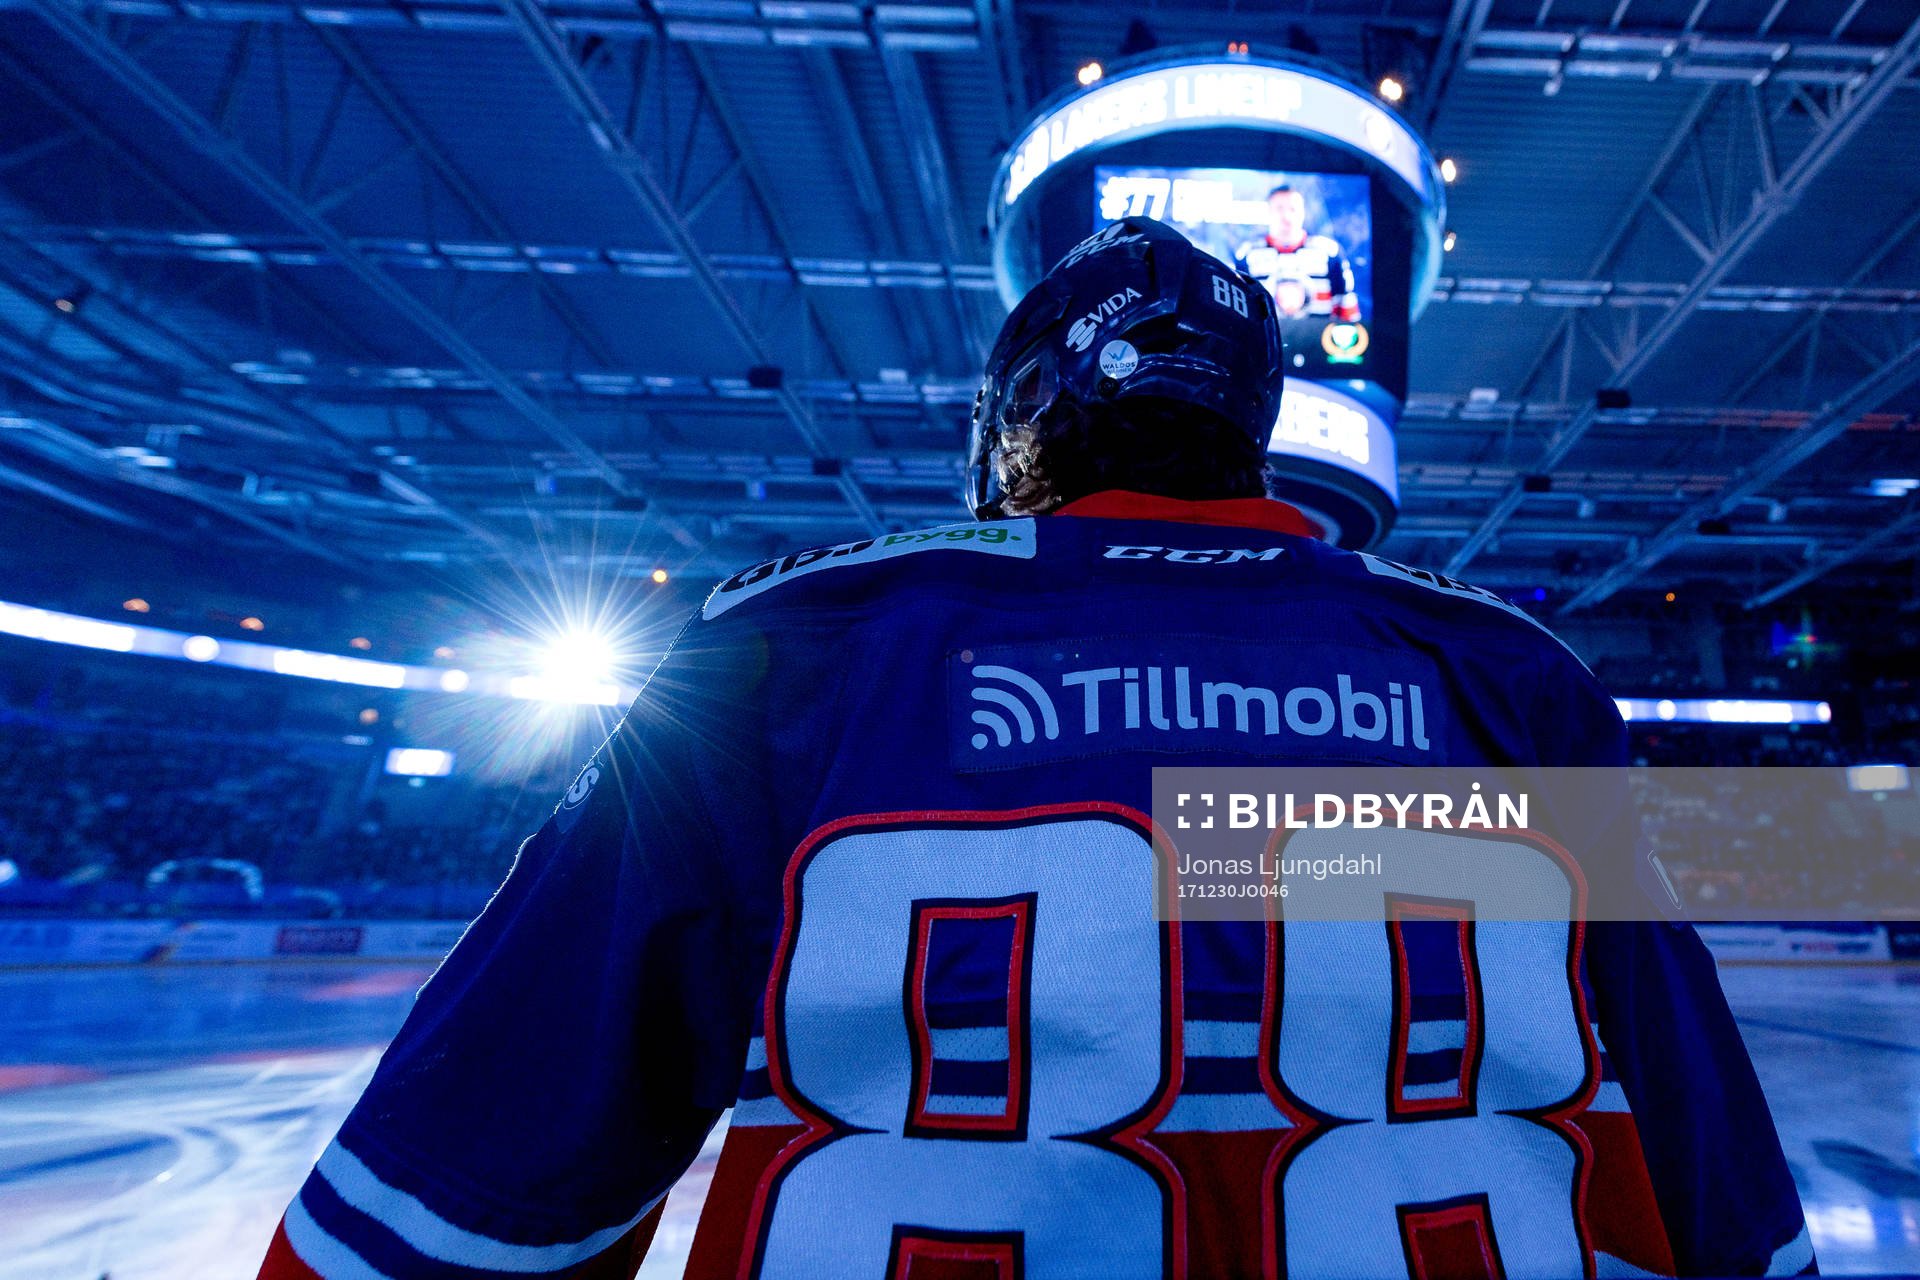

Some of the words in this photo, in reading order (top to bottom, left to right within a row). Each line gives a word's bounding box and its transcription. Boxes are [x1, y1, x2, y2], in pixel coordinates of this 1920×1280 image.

[1087, 287, 1143, 324] VIDA
[1212, 274, 1249, 318] 88
[1102, 545, 1285, 564] CCM
[1062, 666, 1430, 751] Tillmobil
[733, 801, 1606, 1280] 88
